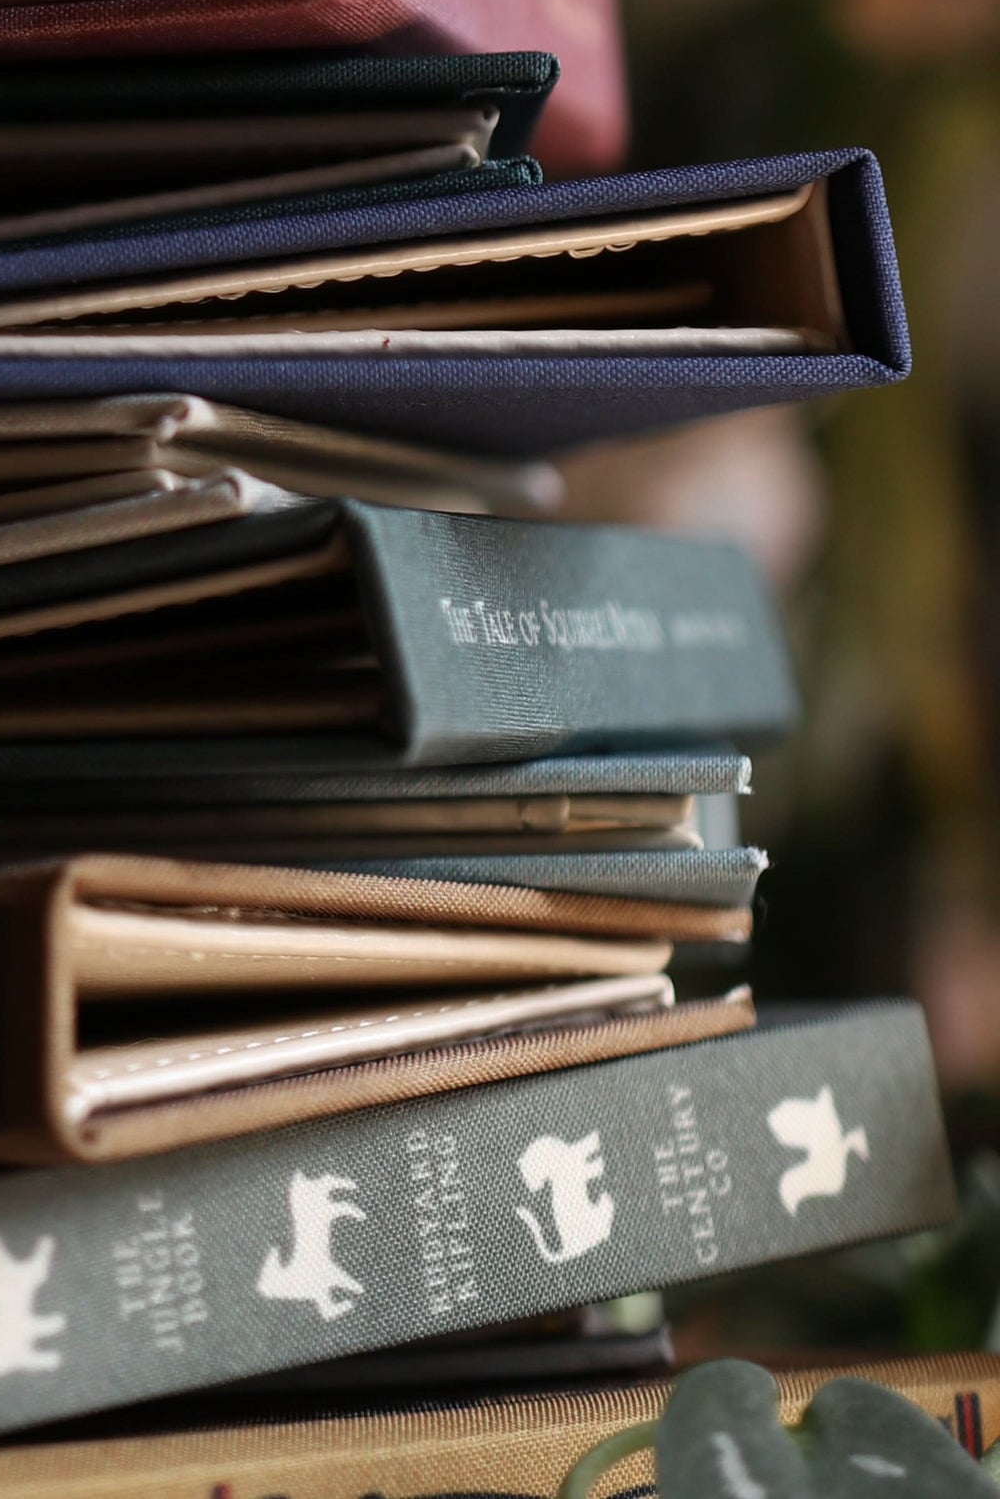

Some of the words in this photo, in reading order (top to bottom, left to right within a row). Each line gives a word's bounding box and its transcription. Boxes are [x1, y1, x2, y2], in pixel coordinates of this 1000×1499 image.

[439, 598, 478, 646] THE
[474, 601, 517, 645] TALE
[517, 610, 541, 647] OF
[402, 1127, 454, 1318] RUDYARD
[432, 1131, 482, 1306] KIPLING
[658, 1141, 684, 1217] THE
[670, 1083, 720, 1264] CENTURY
[111, 1238, 147, 1322] THE
[137, 1190, 184, 1356] JUNGLE
[172, 1210, 209, 1326] BOOK
